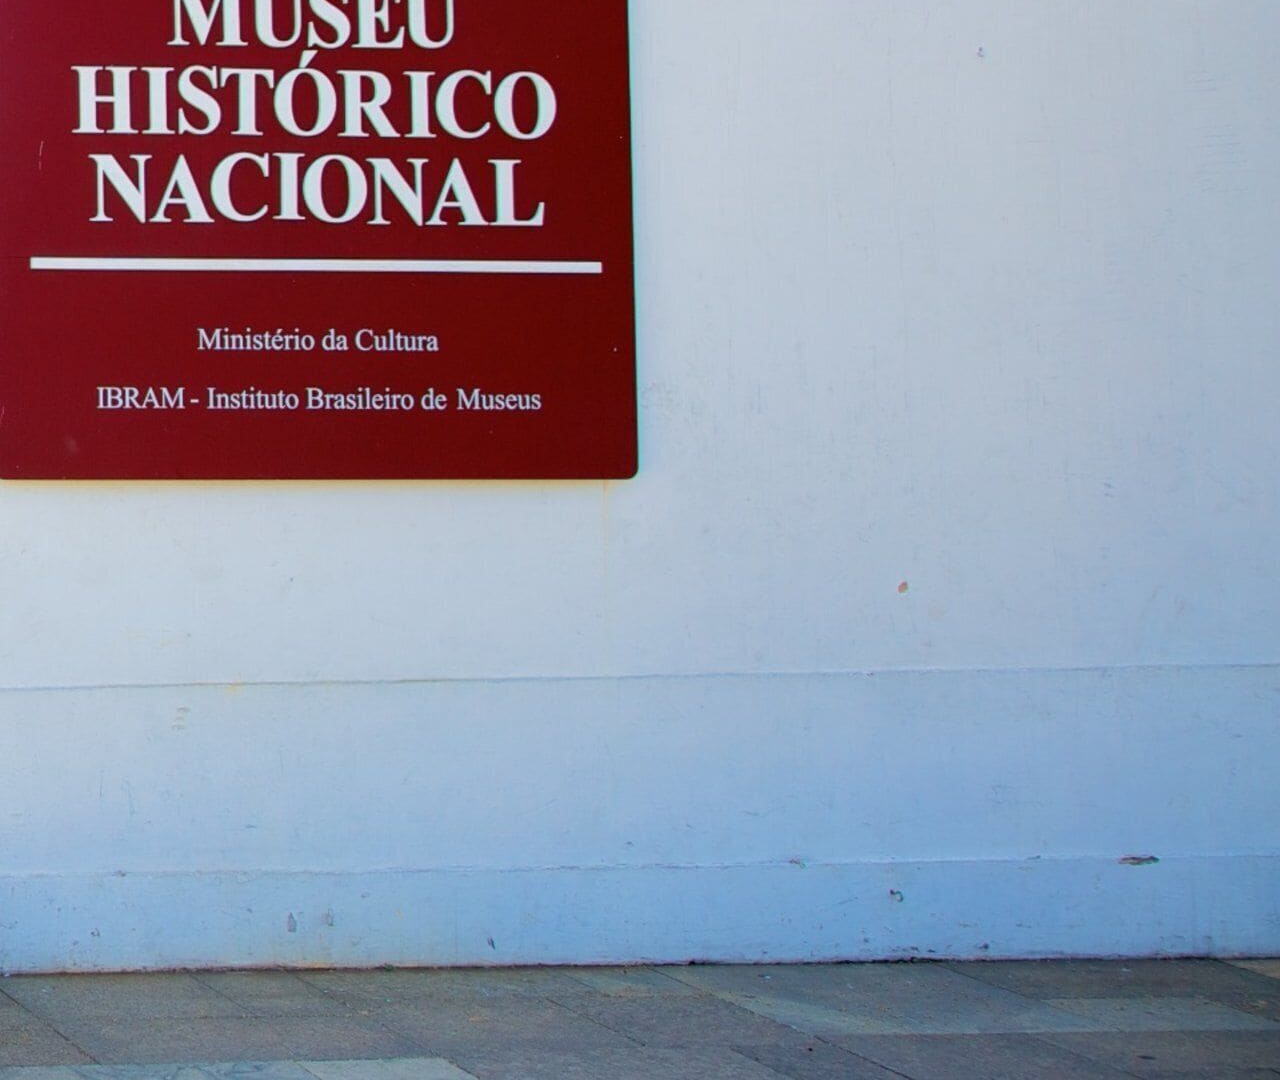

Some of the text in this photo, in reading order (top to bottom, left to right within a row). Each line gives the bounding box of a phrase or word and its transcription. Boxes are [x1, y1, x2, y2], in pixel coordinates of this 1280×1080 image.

[70, 49, 558, 140] HISTÓRICO
[88, 151, 546, 227] NACIONAL
[196, 326, 439, 353] Ministério da Cultura
[95, 386, 185, 410] IBRAM
[206, 385, 300, 411] Instituto
[305, 386, 415, 411] Brasileiro
[420, 386, 447, 411] de
[456, 387, 542, 411] Museus
